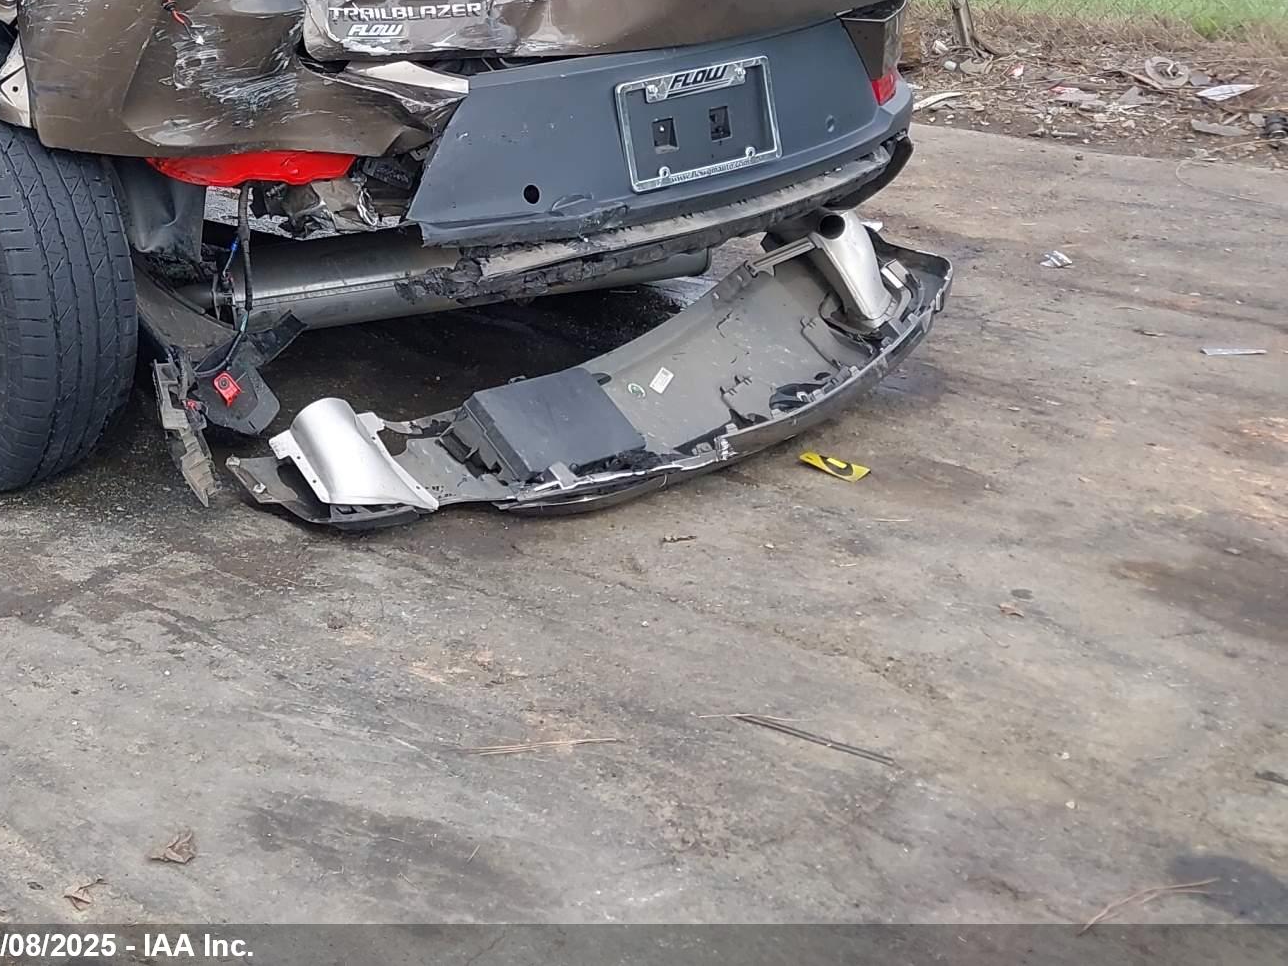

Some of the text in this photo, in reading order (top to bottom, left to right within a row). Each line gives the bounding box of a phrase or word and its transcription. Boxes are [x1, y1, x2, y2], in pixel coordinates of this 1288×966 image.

[327, 1, 482, 21] TRAILBLAZER
[347, 23, 403, 37] FLOW
[669, 64, 729, 90] FLOW
